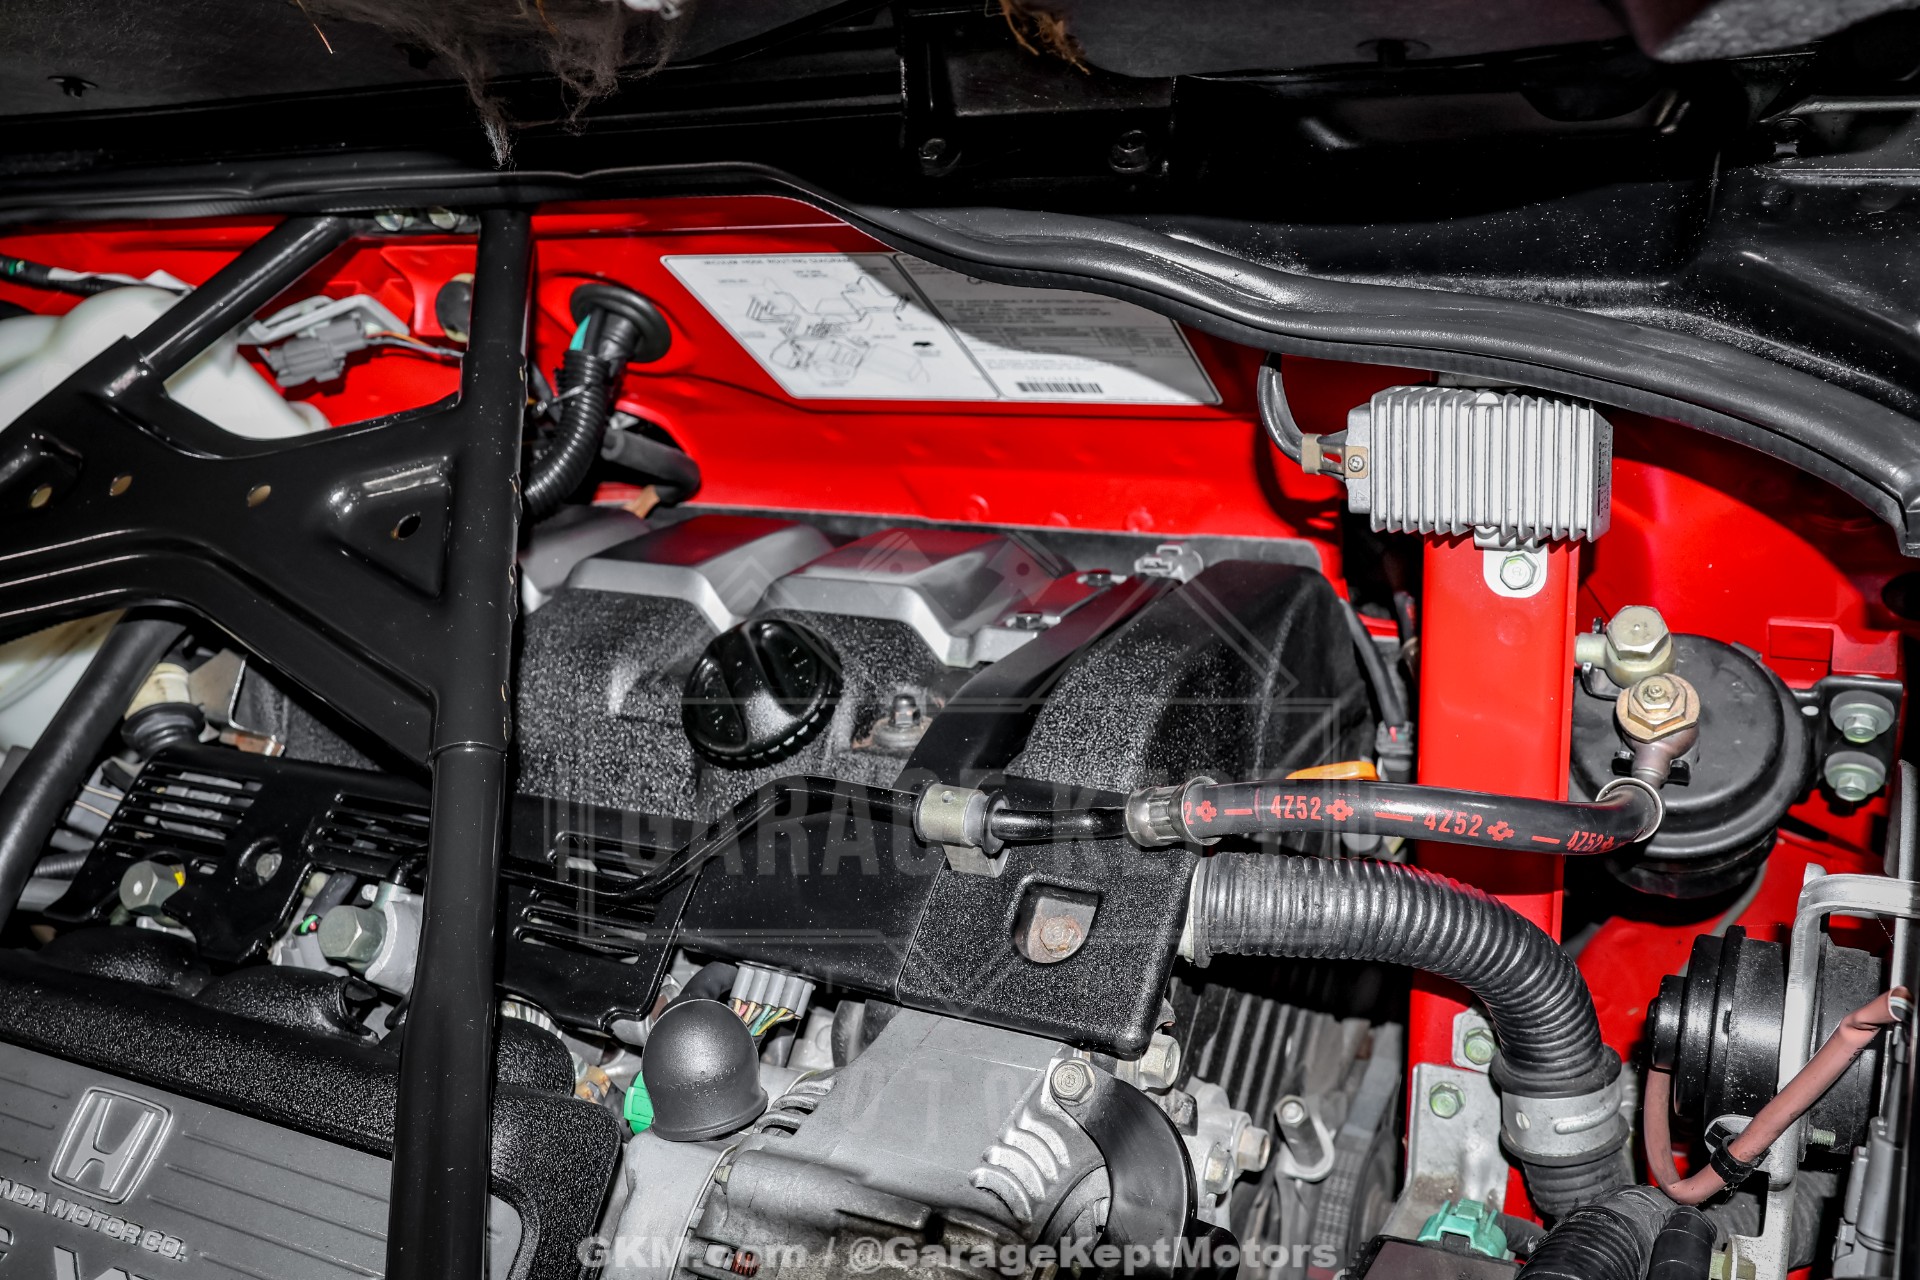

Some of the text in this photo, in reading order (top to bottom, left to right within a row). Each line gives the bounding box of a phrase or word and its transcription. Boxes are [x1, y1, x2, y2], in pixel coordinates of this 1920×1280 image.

[1271, 795, 1322, 820] 4Z52
[1423, 809, 1483, 837] 4Z52
[1567, 830, 1604, 851] 4Z52
[0, 1177, 49, 1213] NDA
[52, 1199, 144, 1246] MOTOR
